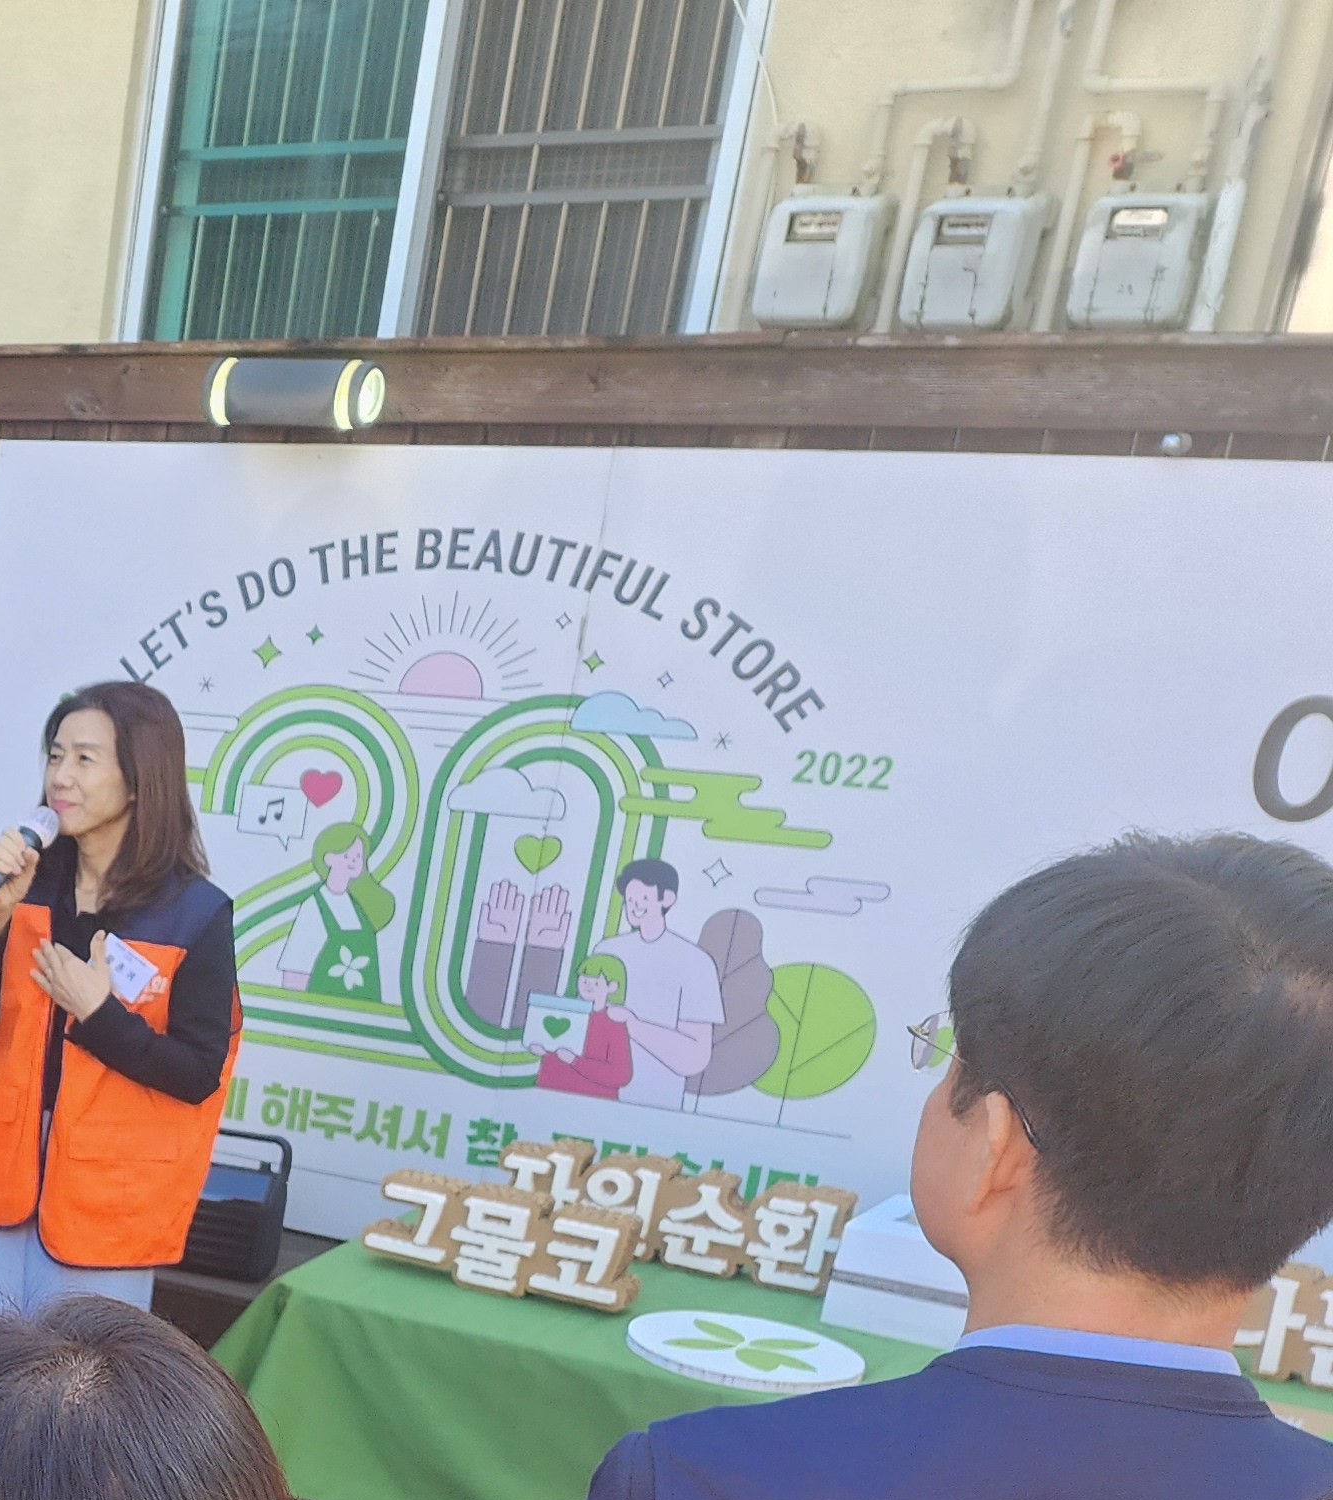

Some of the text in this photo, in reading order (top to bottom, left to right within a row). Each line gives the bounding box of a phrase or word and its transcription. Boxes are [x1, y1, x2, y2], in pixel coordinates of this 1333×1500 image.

[119, 527, 826, 734] LET'S DO THE BEAUTIFUL STORE
[792, 749, 894, 791] 2022
[260, 1082, 452, 1159] 해주셔서
[364, 1181, 619, 1306] 그물코
